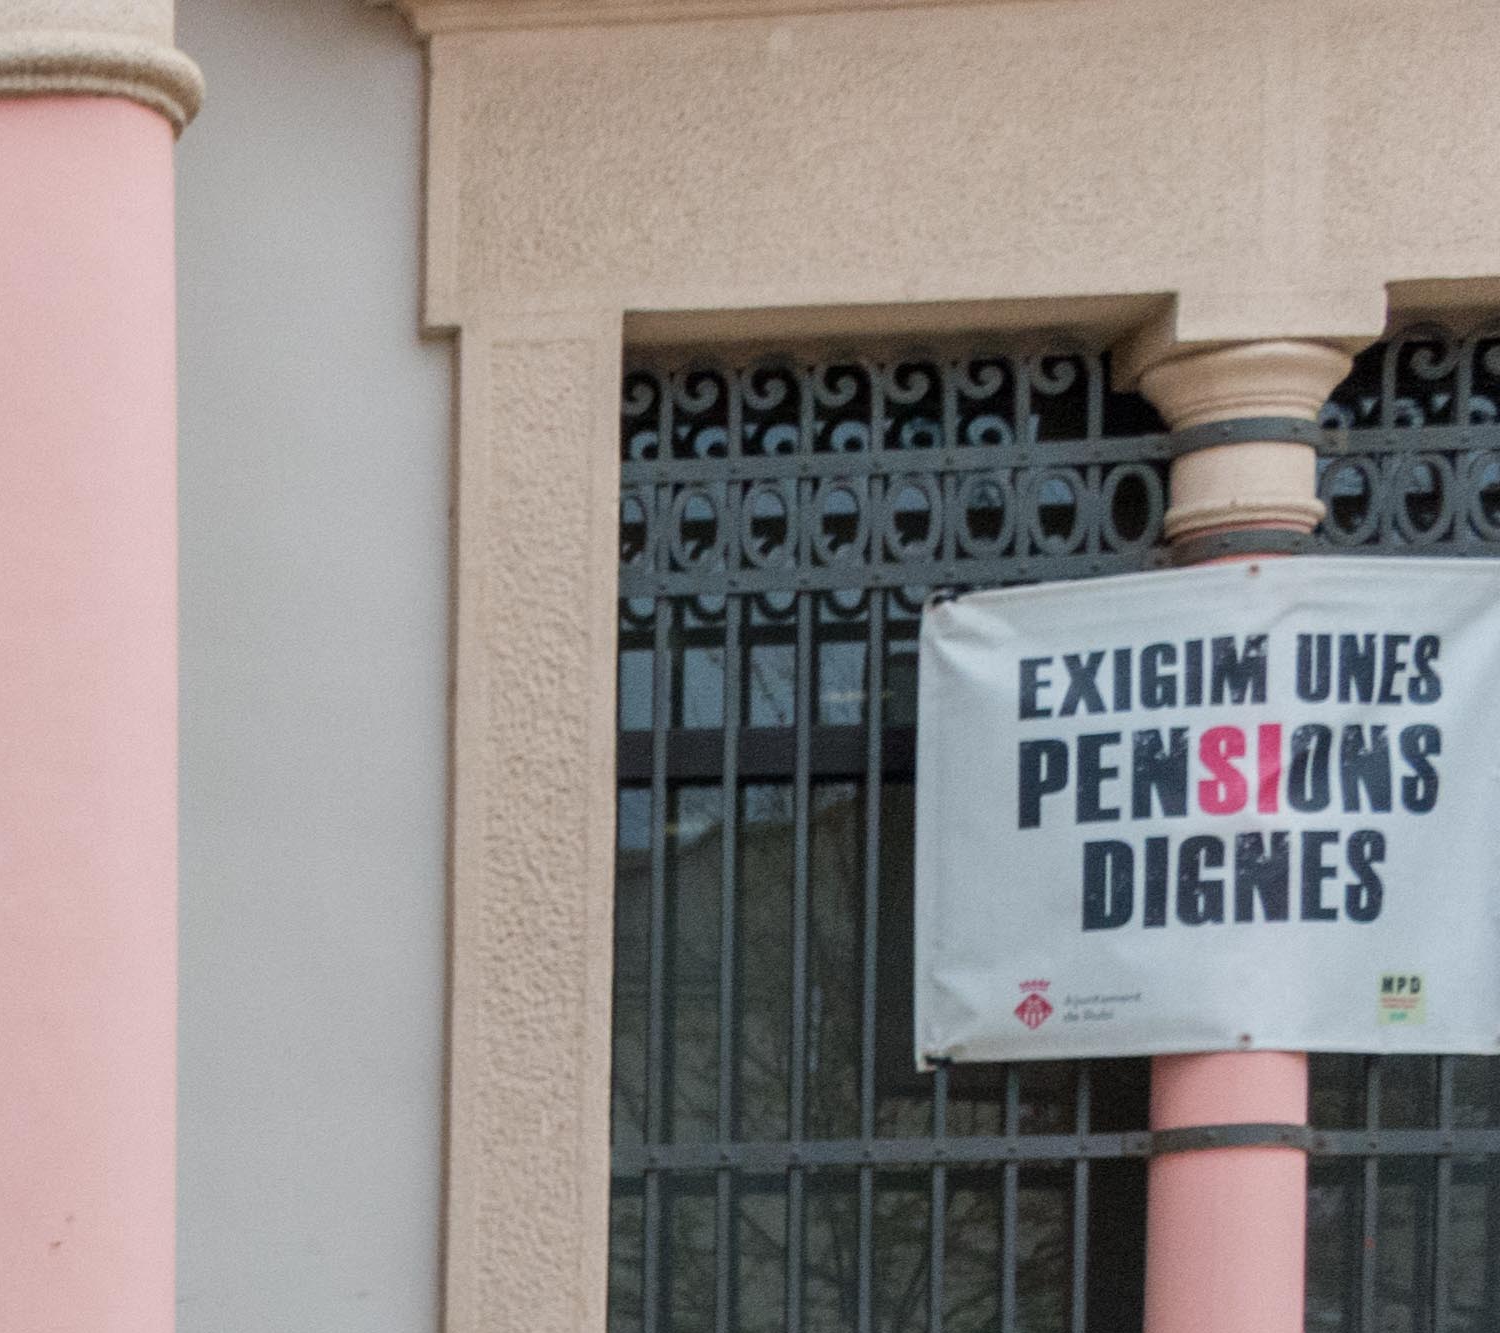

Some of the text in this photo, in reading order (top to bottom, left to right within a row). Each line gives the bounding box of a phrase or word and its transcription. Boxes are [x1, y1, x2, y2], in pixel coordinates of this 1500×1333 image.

[1019, 633, 1441, 720] EXIGIM UNES
[1019, 723, 1441, 829] PENSIONS
[1081, 829, 1387, 932] DIGNES
